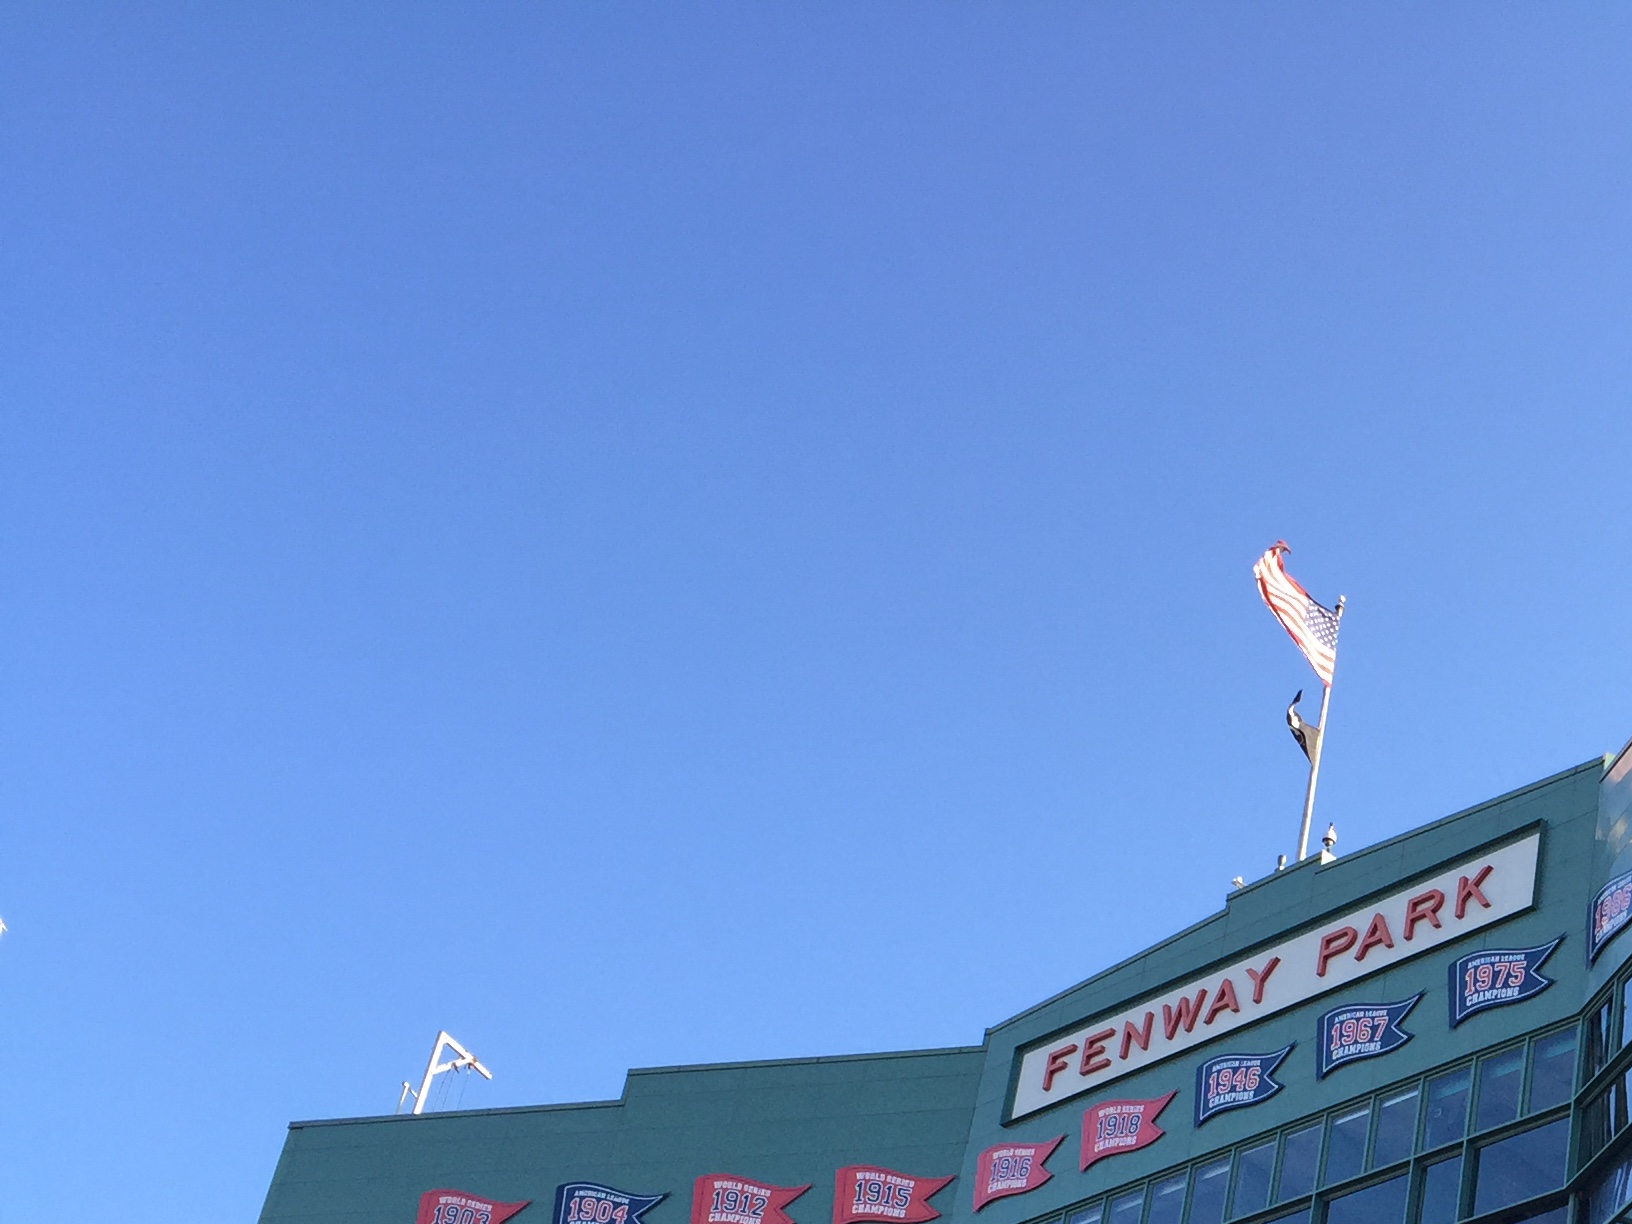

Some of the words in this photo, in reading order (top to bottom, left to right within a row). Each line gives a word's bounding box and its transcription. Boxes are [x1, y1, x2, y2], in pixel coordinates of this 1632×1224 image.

[1595, 882, 1632, 935] 1986
[1467, 955, 1500, 969] AMERICAN
[1500, 953, 1526, 962] LEAGUE
[1042, 956, 1281, 1092] FENWAY
[1316, 864, 1495, 978] PARK
[1465, 961, 1527, 997] 1975
[1466, 986, 1520, 1007] CHAMPIONS
[1334, 1011, 1365, 1024] AMERICAN
[1365, 1009, 1388, 1018] LEAGUE
[1331, 1016, 1389, 1051] 1967
[1332, 1041, 1382, 1060] CHAMPIONS
[1208, 1066, 1261, 1099] 1946
[1209, 1090, 1255, 1109] CHAMPIONS
[1098, 1105, 1121, 1117] WORLD
[1096, 1113, 1142, 1142] 1918
[1094, 1135, 1137, 1153] CHAMPIONS
[856, 1171, 885, 1182] WORLD
[886, 1174, 915, 1188] SERIES
[989, 1156, 1032, 1184] 1916
[714, 1180, 742, 1191] WORLD
[853, 1180, 913, 1209] 1915
[987, 1178, 1027, 1194] CHAMPIONS
[439, 1196, 466, 1206] WORLD
[710, 1188, 768, 1218] 1912
[852, 1204, 906, 1218] CHAMPIONS
